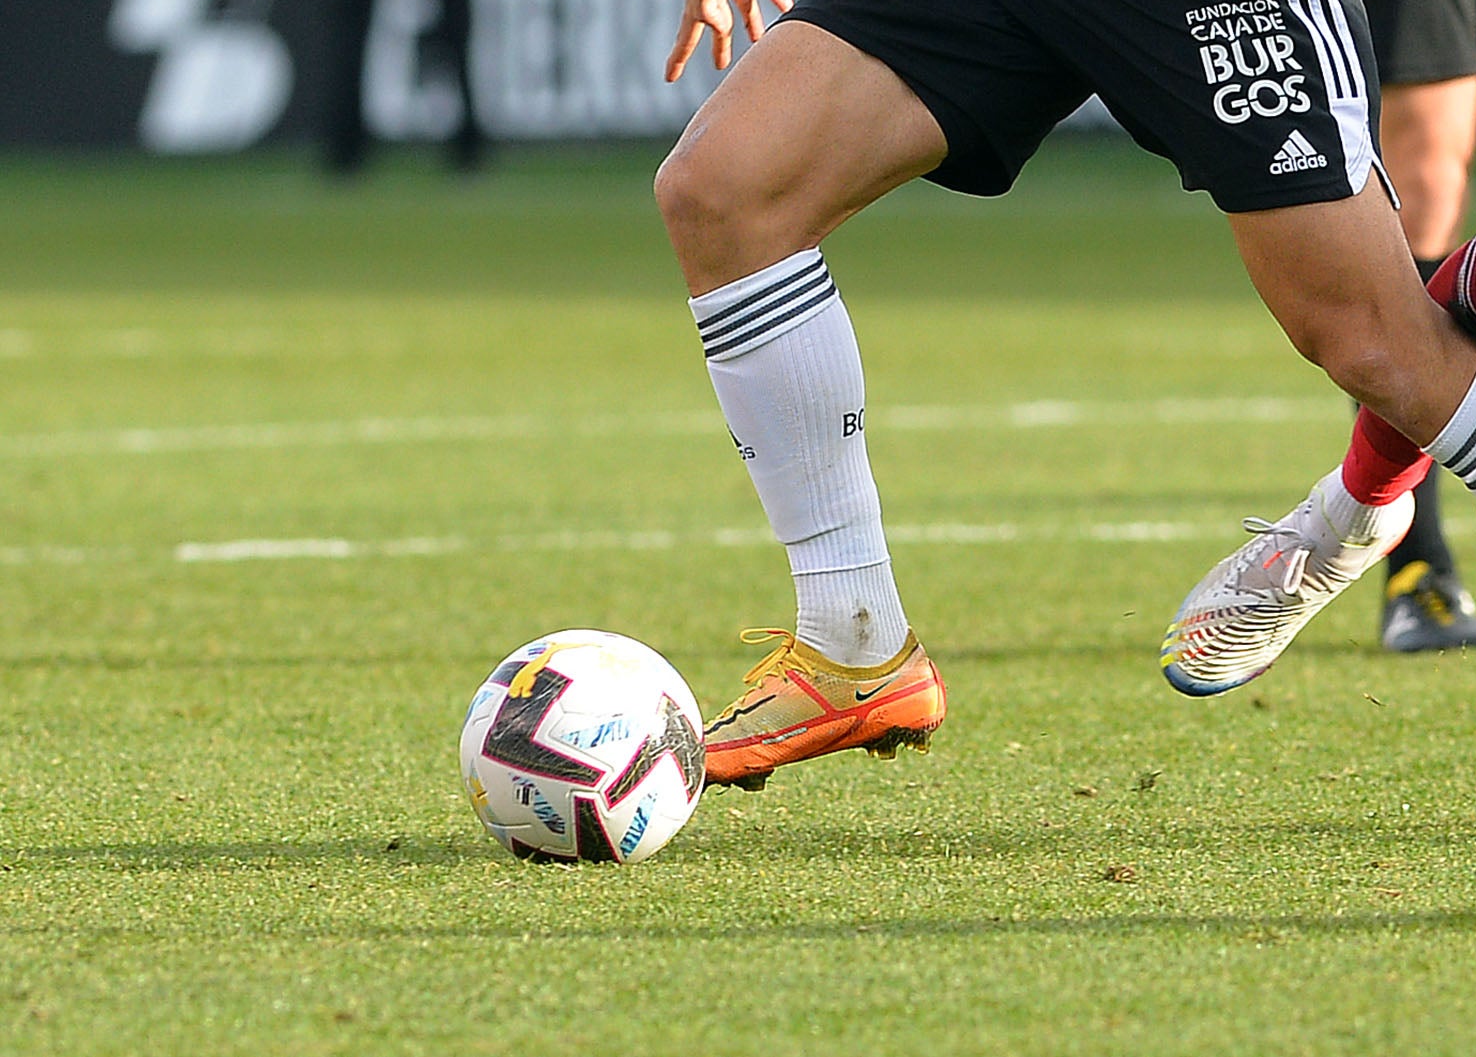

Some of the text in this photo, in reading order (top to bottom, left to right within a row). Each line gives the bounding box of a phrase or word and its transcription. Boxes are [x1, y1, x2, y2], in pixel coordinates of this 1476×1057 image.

[1190, 12, 1287, 42] CAJA DE
[1199, 34, 1304, 85] BUR
[1213, 74, 1312, 125] GOS
[1269, 154, 1328, 175] adidas
